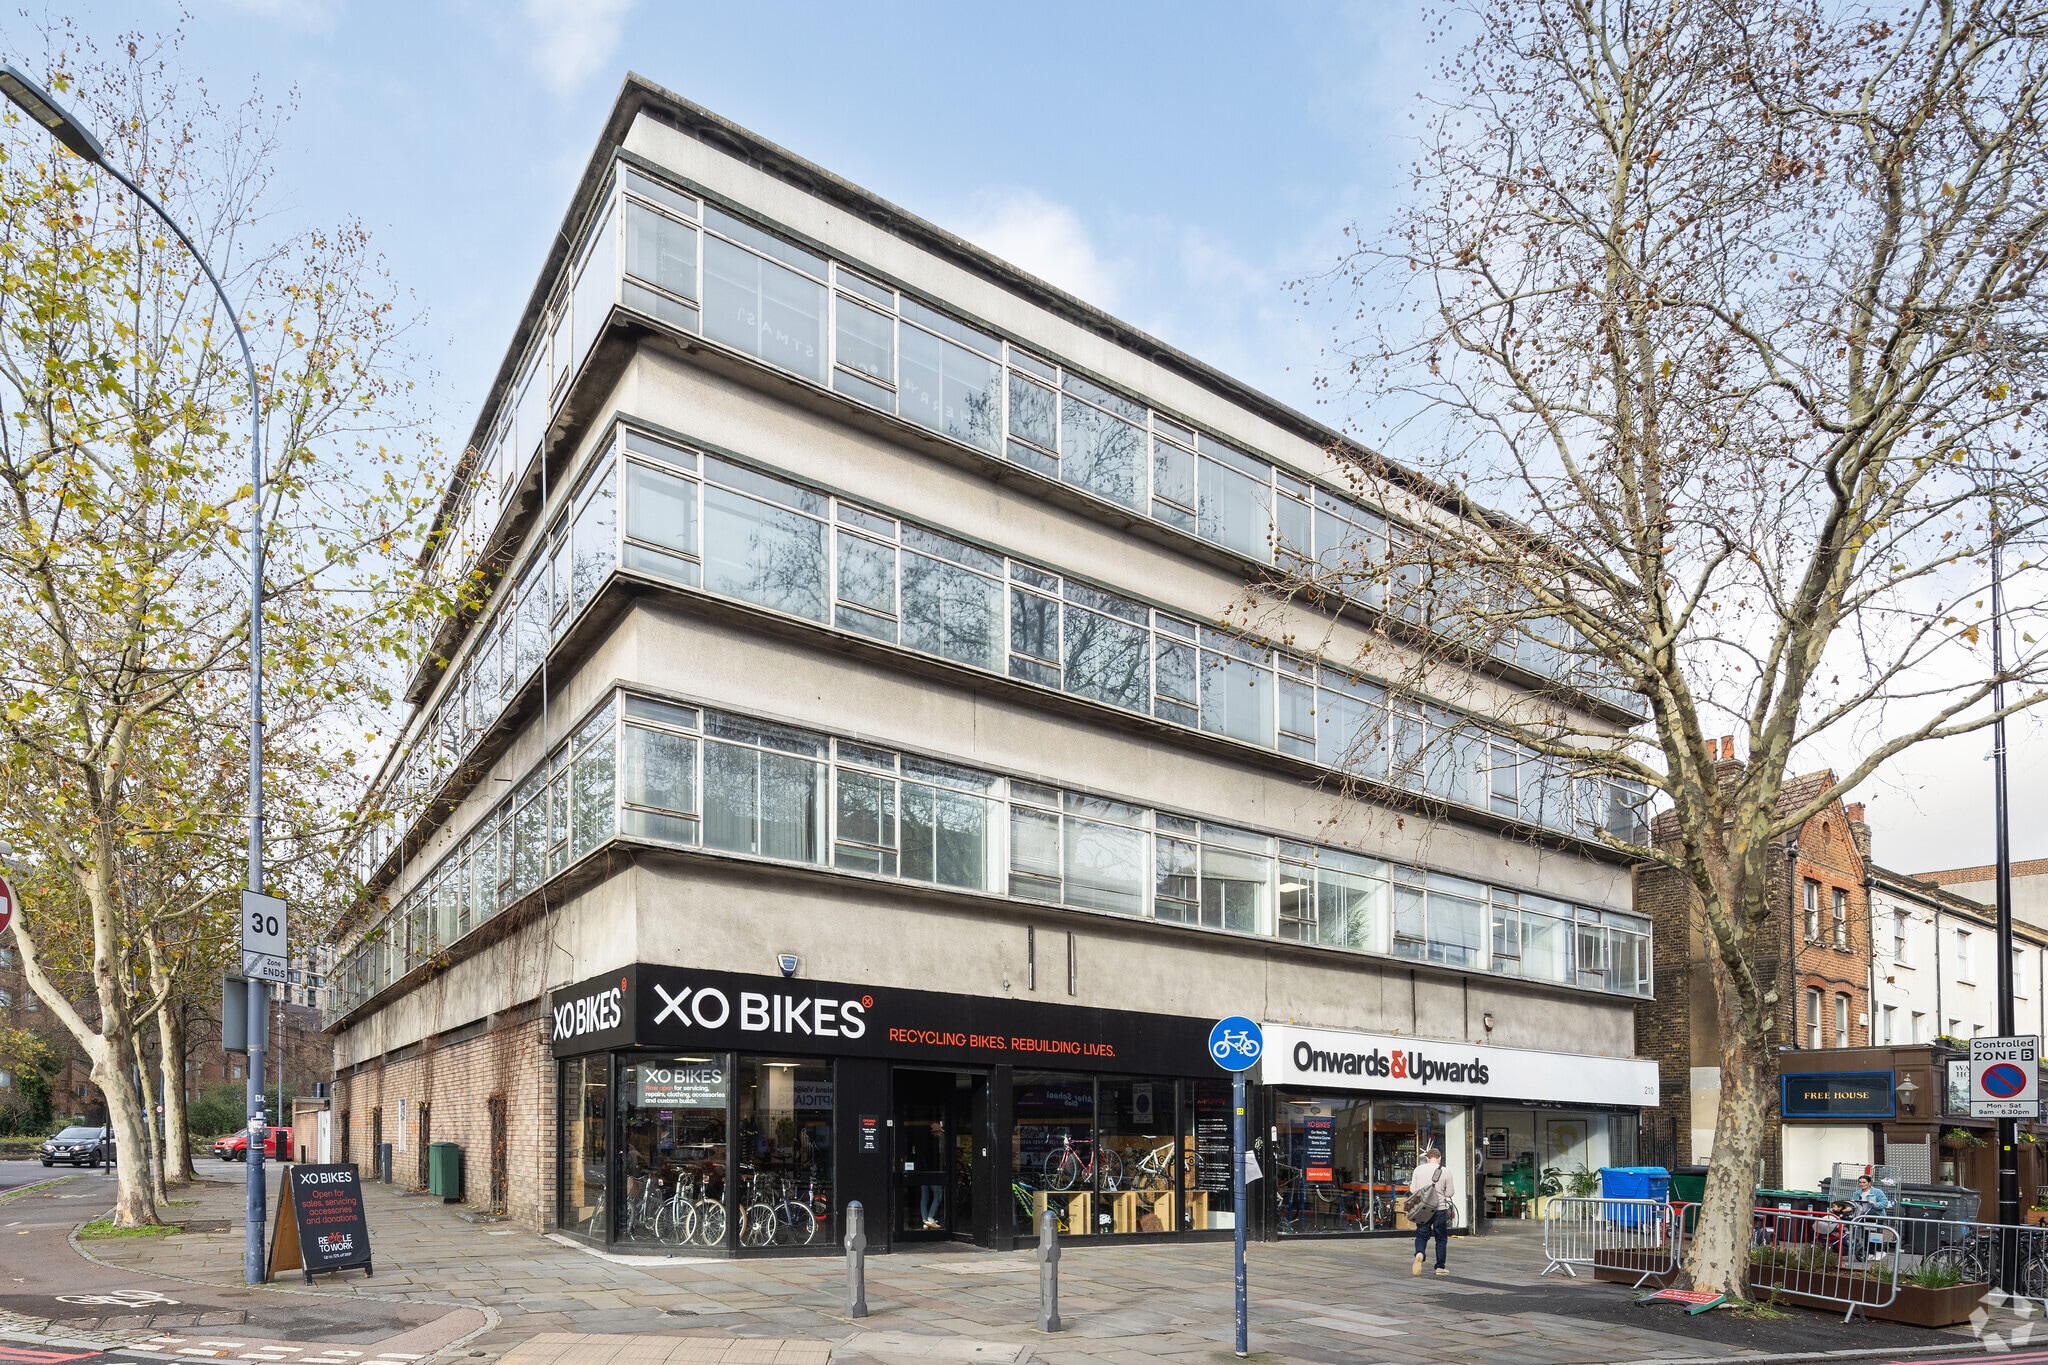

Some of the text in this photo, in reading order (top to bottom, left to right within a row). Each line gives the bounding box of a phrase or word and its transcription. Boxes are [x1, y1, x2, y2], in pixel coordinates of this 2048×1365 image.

[252, 912, 278, 936] 30
[267, 958, 281, 967] Zone
[263, 967, 285, 978] ENDS
[553, 987, 622, 1042] XO BIKES
[653, 984, 866, 1039] XO BIKES
[890, 1028, 1116, 1057] RECYCLING BIKES. REBUILDING LIVES.
[1974, 1039, 2034, 1048] Controlled
[1974, 1050, 2033, 1060] ZONE B
[645, 1069, 722, 1084] XO BIKES
[300, 1171, 352, 1184] XO BIKES
[312, 1189, 344, 1199] Open for
[302, 1198, 357, 1208] sales, servicing
[309, 1207, 352, 1216] accessories
[322, 1214, 358, 1223] donations
[318, 1232, 352, 1245] RECYCLE
[319, 1242, 353, 1252] TO WORK
